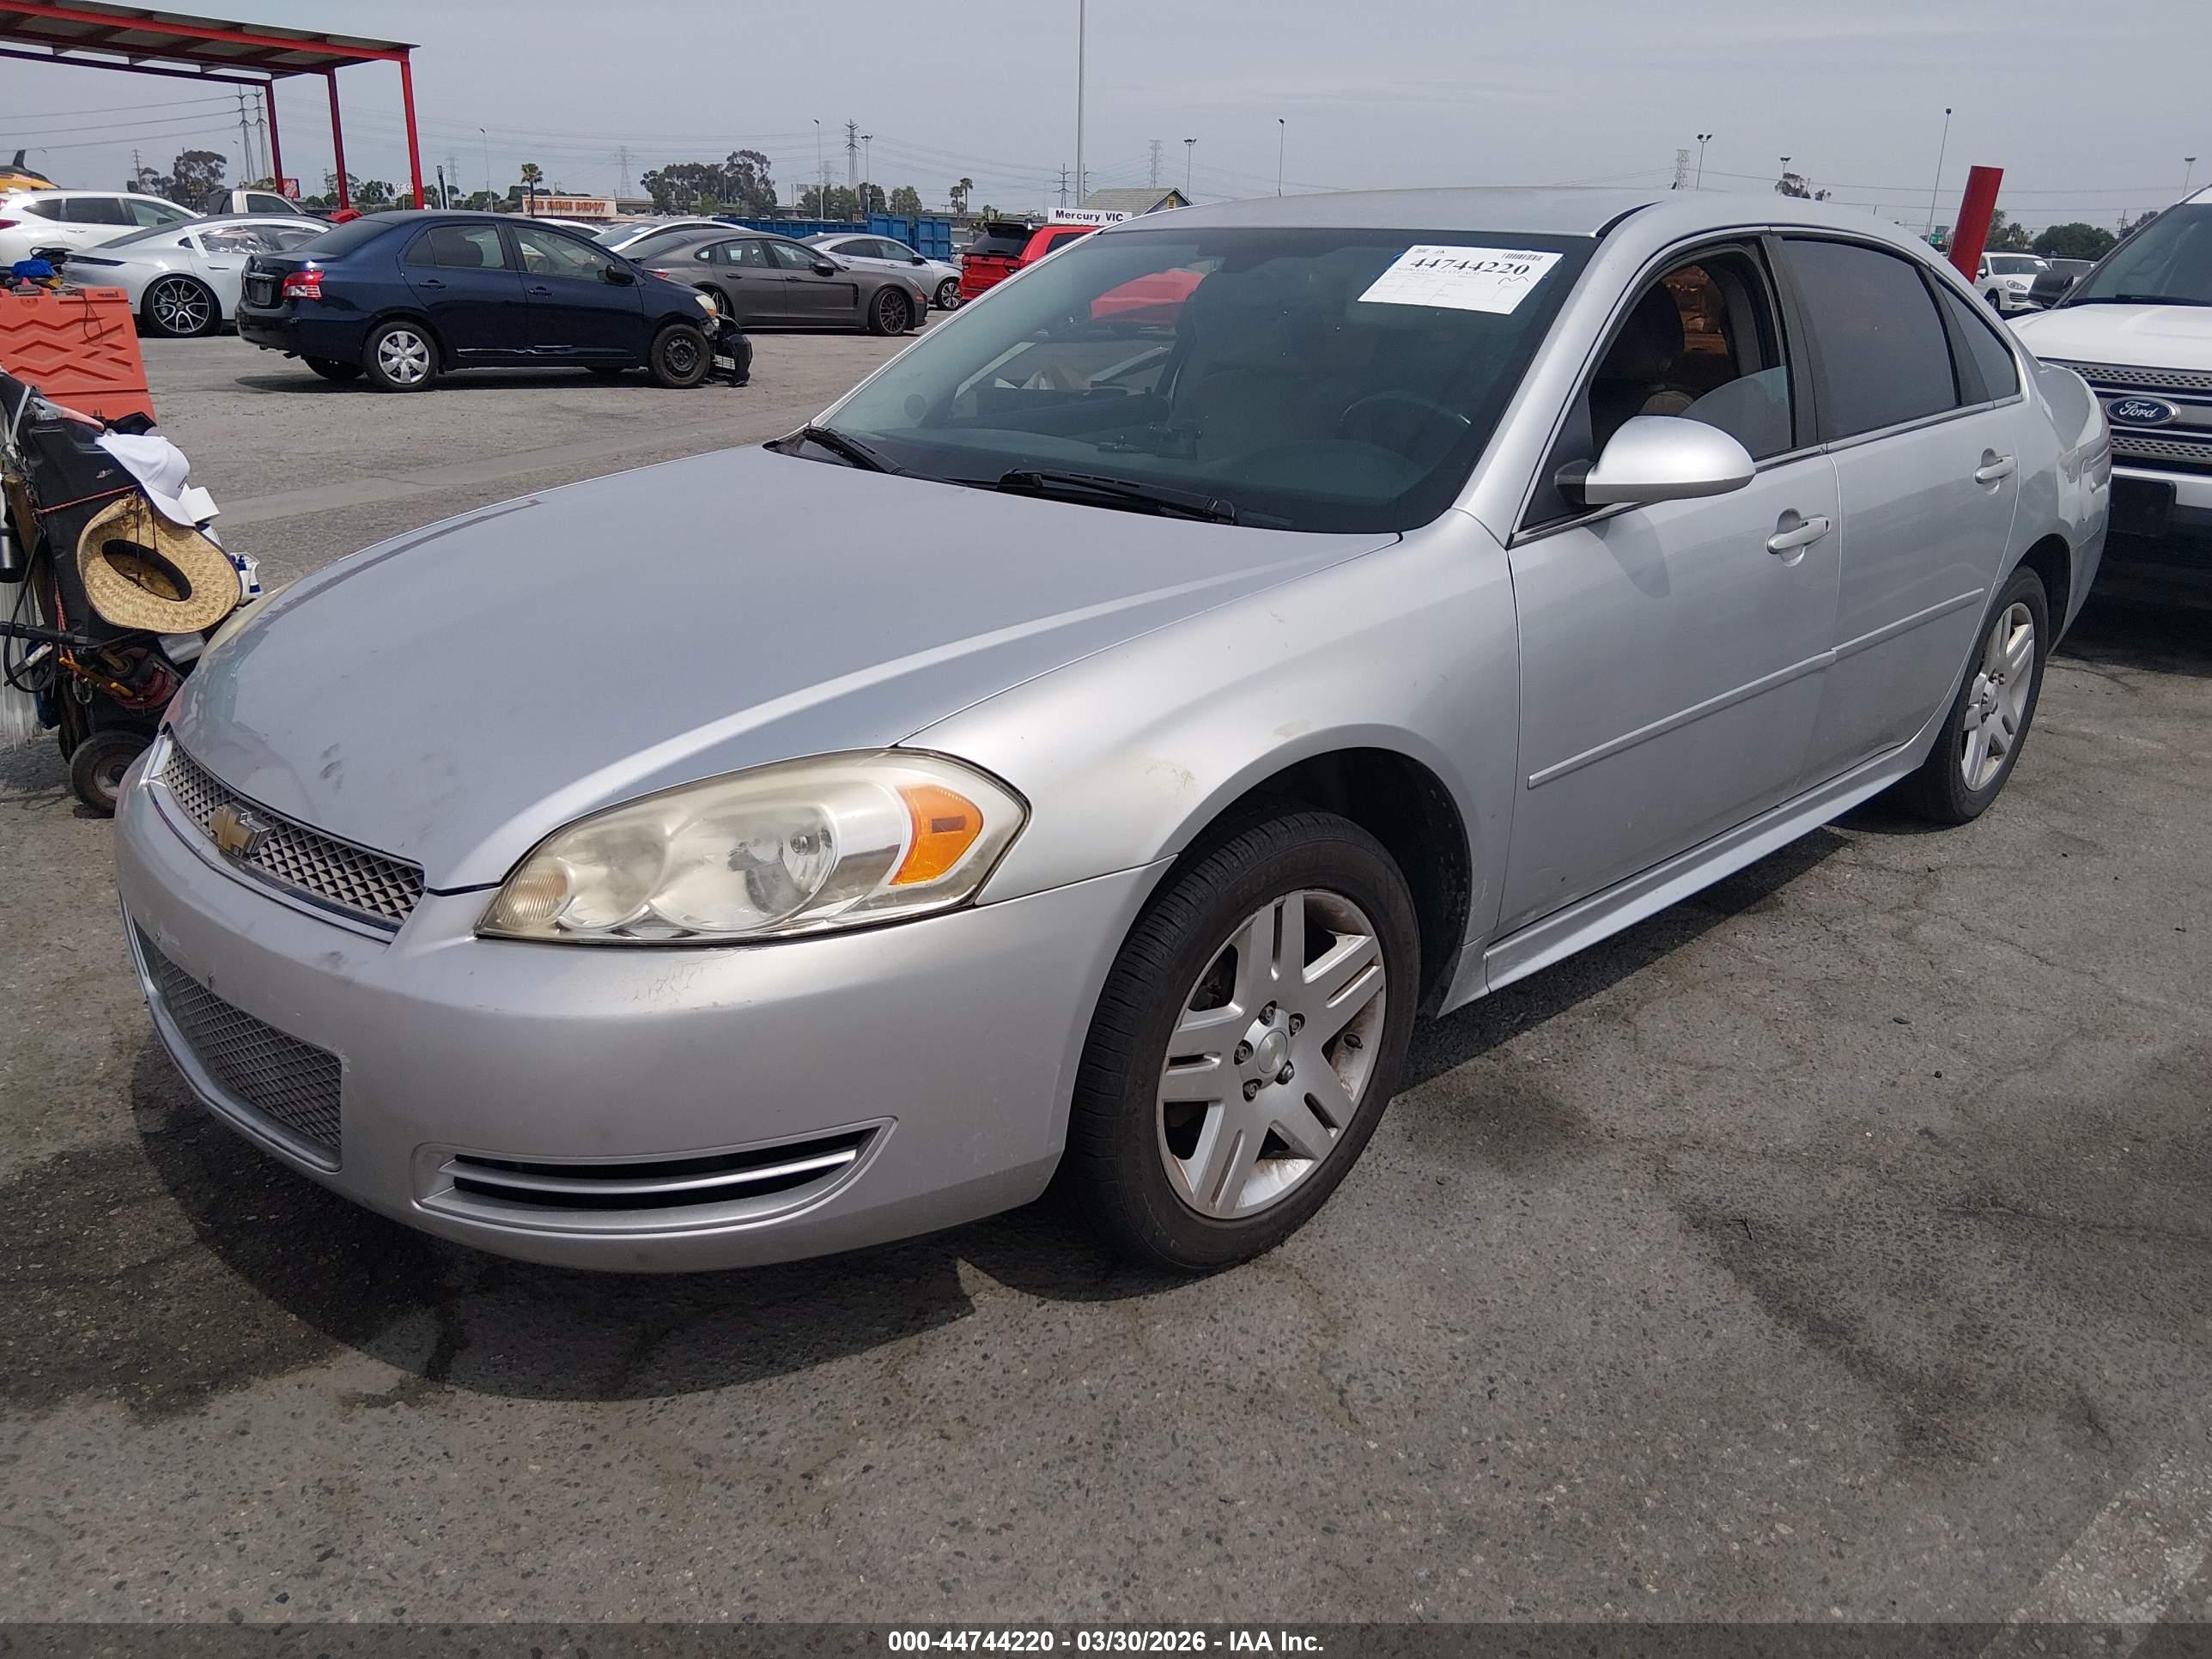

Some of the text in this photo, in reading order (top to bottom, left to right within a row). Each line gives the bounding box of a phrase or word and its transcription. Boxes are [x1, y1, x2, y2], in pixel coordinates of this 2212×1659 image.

[525, 200, 544, 211] TE
[1055, 210, 1124, 222] Mercury VIC
[1410, 258, 1530, 275] 44744220
[2118, 401, 2160, 417] Ford
